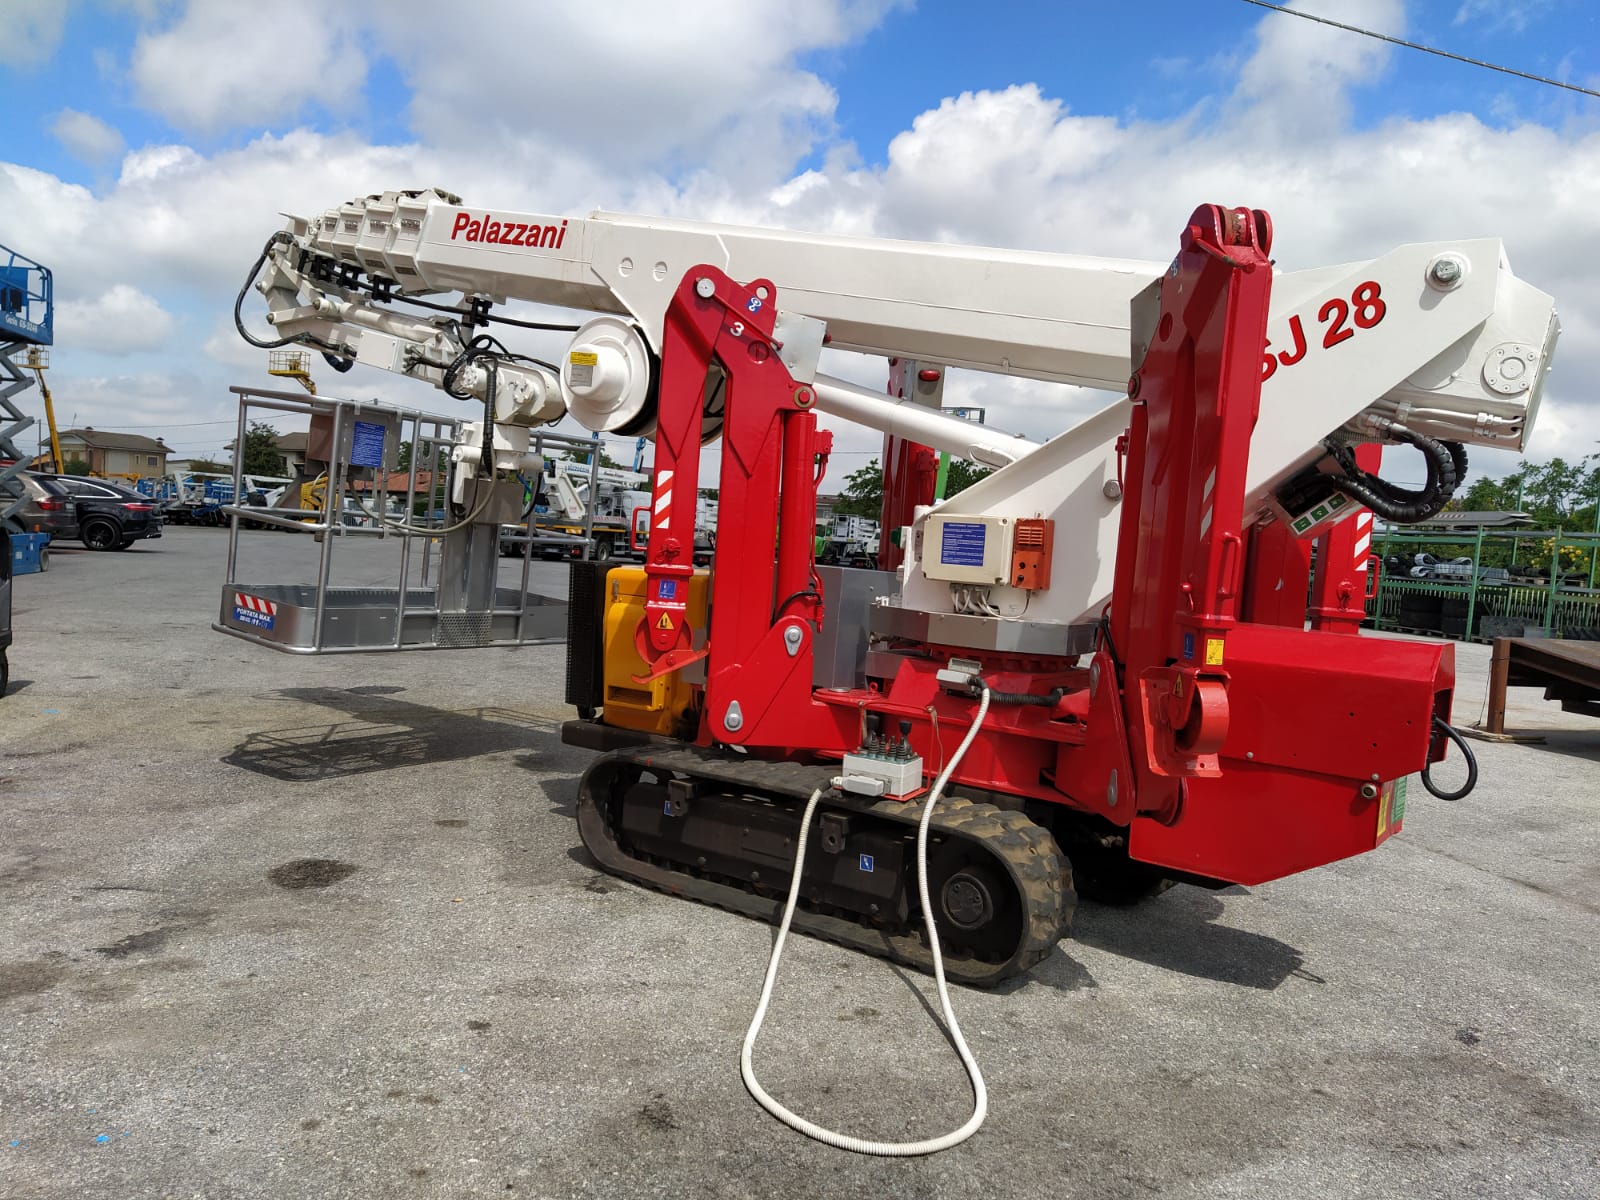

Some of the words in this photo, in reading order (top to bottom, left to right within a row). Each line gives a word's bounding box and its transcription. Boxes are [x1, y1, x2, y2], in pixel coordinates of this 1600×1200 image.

[451, 212, 568, 249] Palazzani
[1318, 281, 1387, 350] 28
[729, 321, 745, 337] 3
[236, 607, 259, 619] PORTATA
